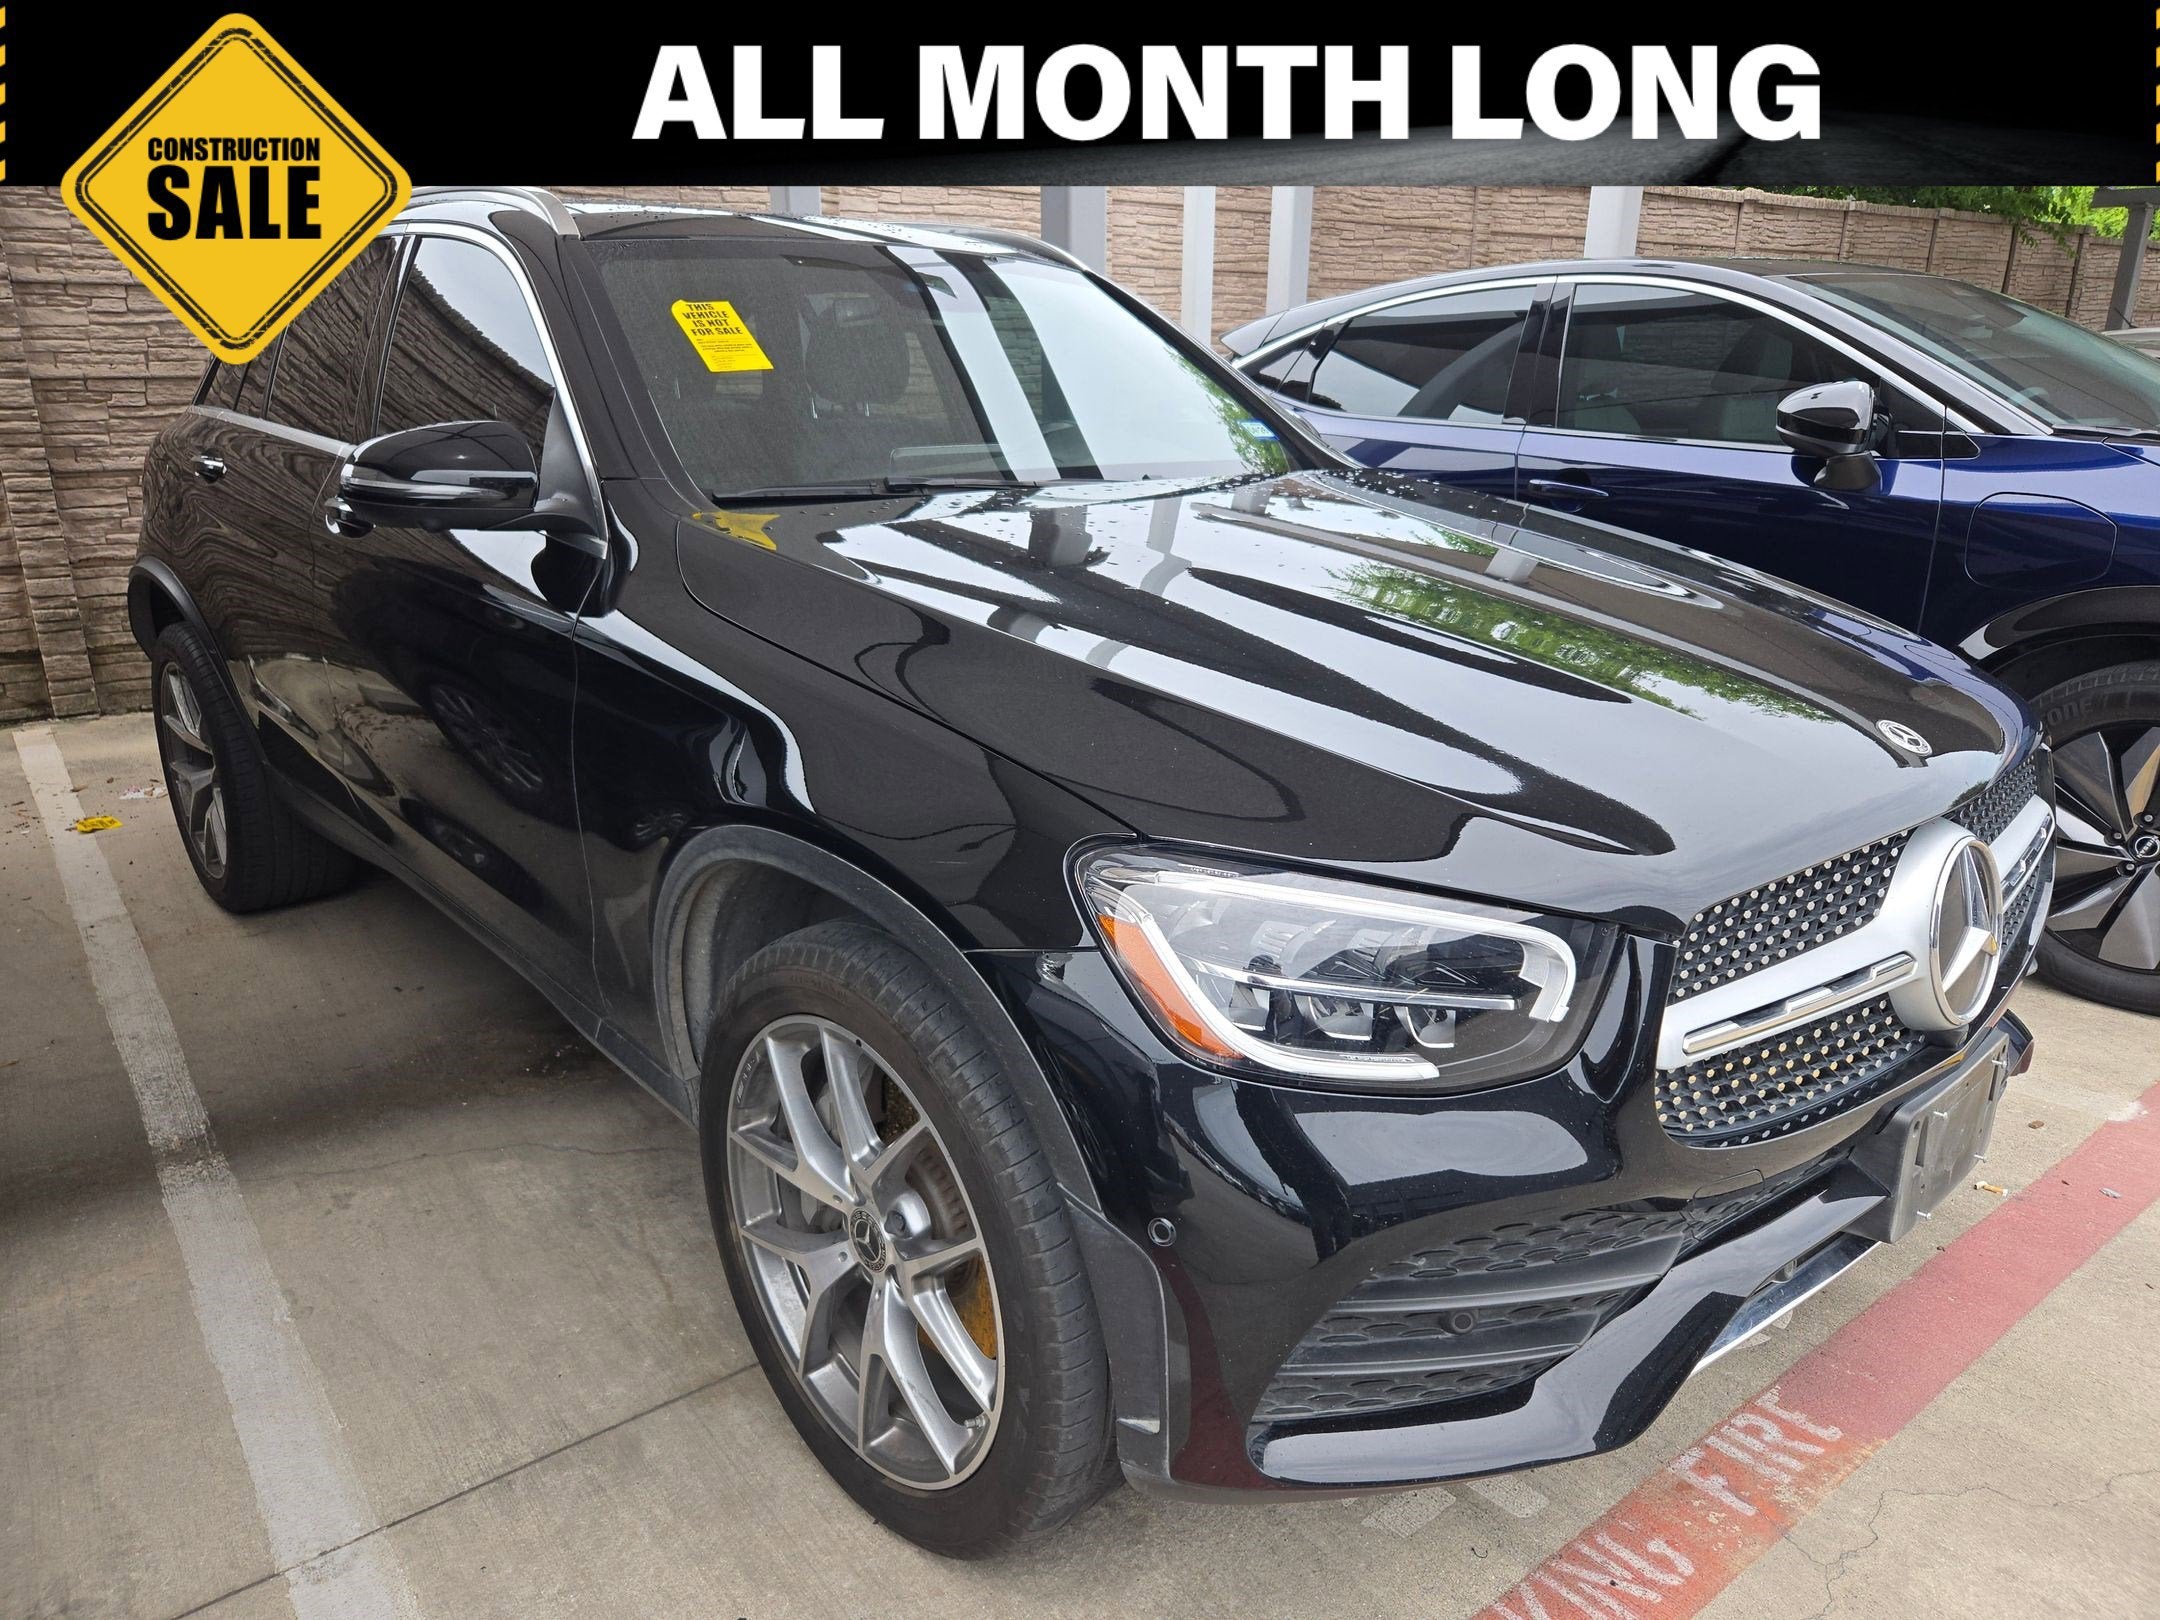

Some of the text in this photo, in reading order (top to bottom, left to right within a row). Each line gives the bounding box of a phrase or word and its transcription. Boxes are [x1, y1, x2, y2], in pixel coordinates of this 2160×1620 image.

[682, 311, 729, 320] VEHICLE
[692, 319, 730, 328] IS NOT
[691, 327, 743, 336] FOR SALE
[1668, 1385, 1843, 1516] FIRE
